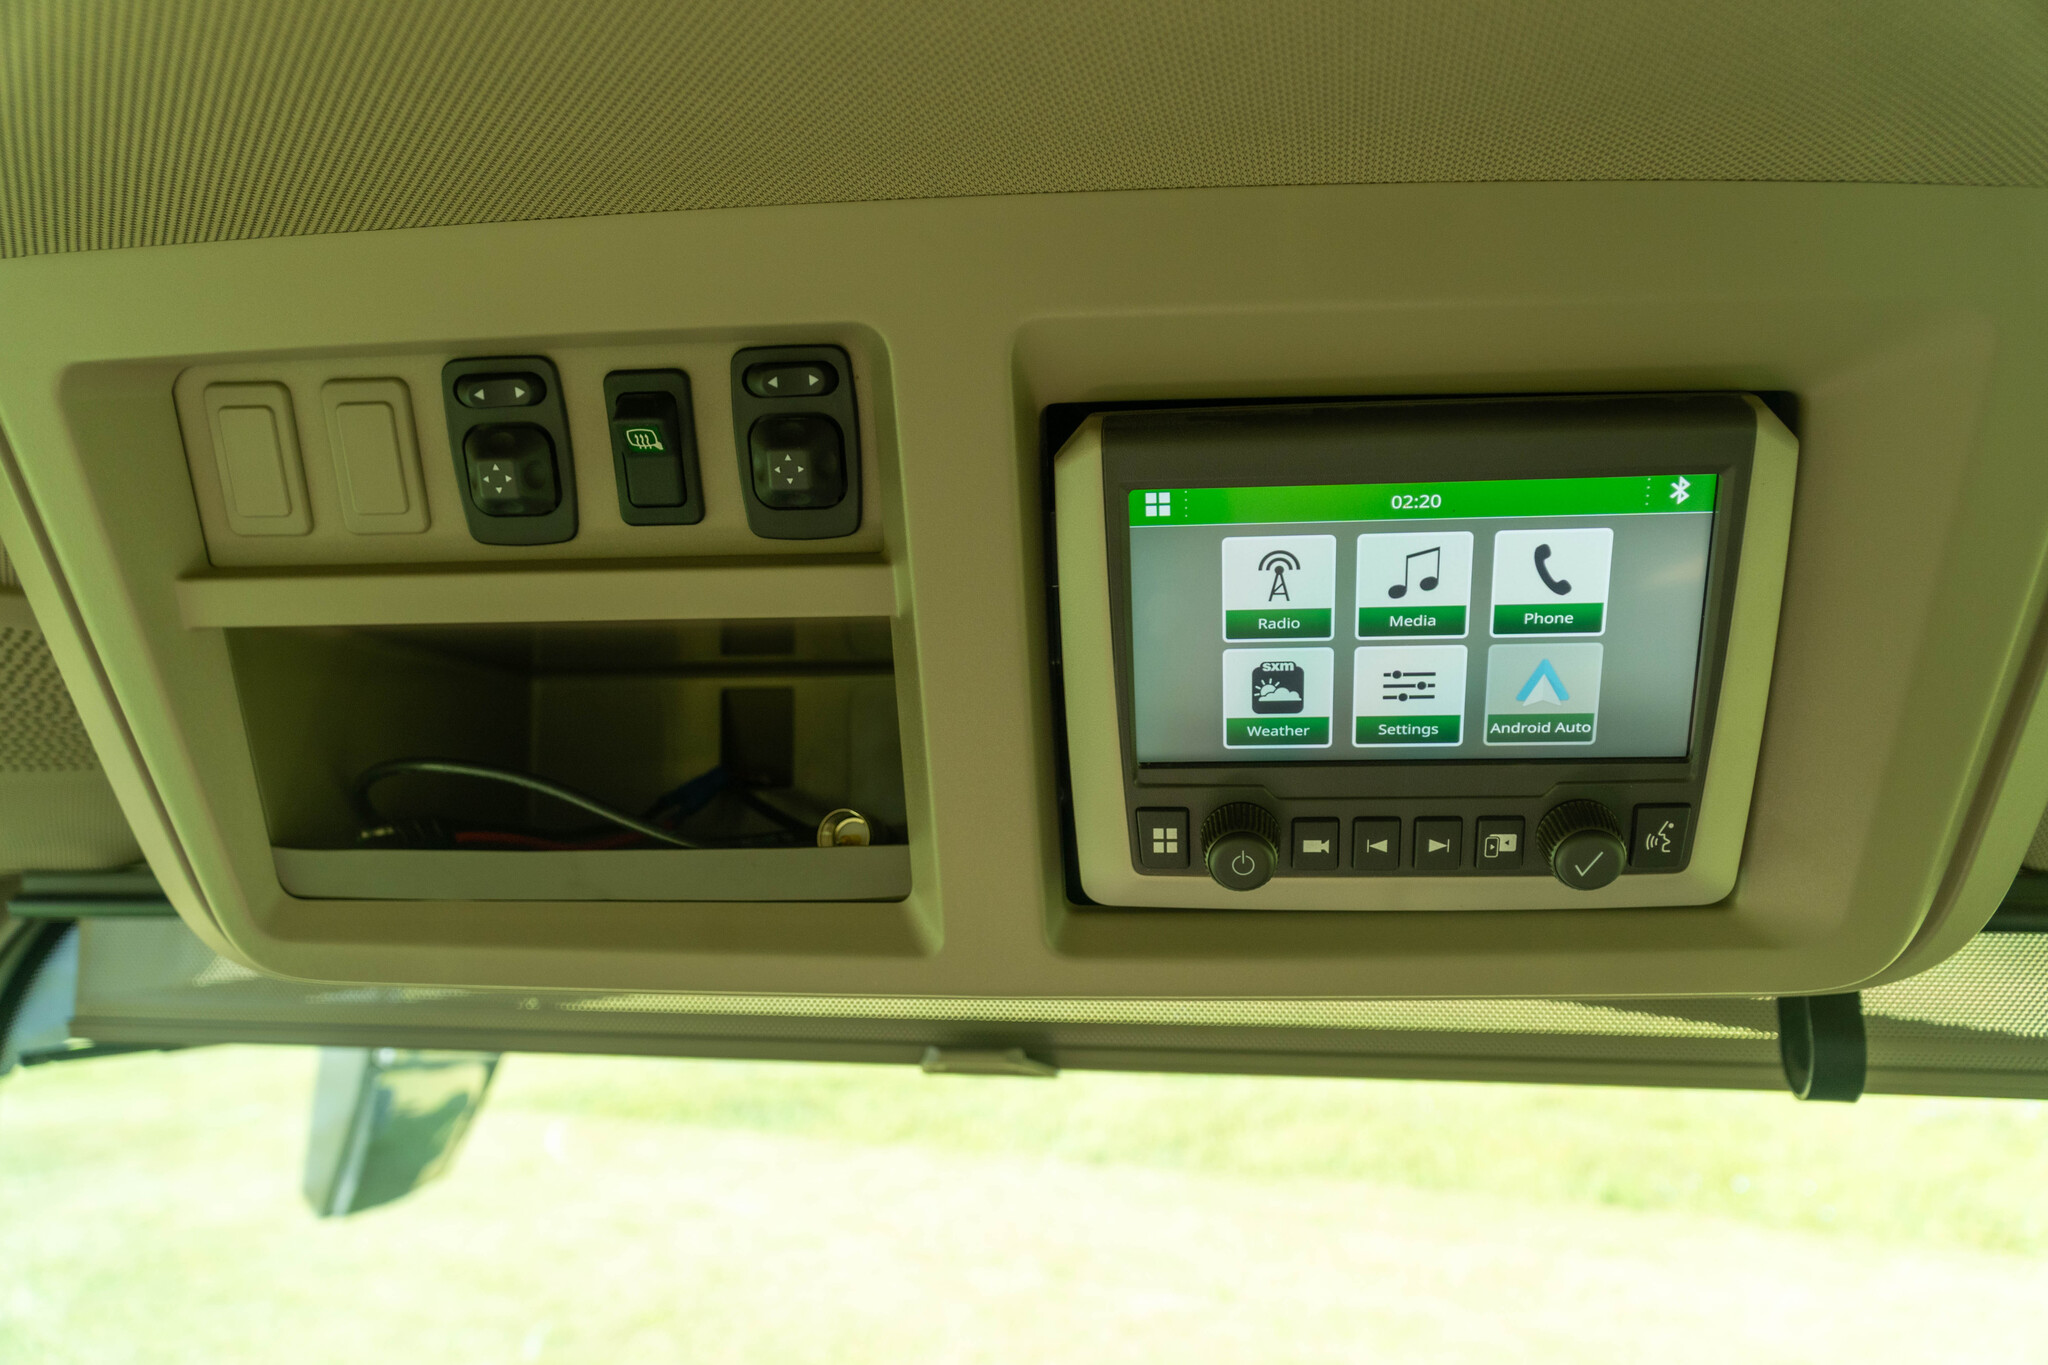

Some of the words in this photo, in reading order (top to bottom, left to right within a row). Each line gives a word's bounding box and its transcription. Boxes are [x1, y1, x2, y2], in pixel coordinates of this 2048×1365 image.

[1391, 494, 1442, 510] 02:20
[1257, 617, 1301, 630] Radio
[1389, 614, 1437, 628] Media
[1524, 612, 1574, 625] Phone
[1246, 725, 1310, 737] Weather
[1377, 723, 1439, 738] Settings
[1490, 721, 1550, 735] Android
[1554, 721, 1592, 734] Auto
